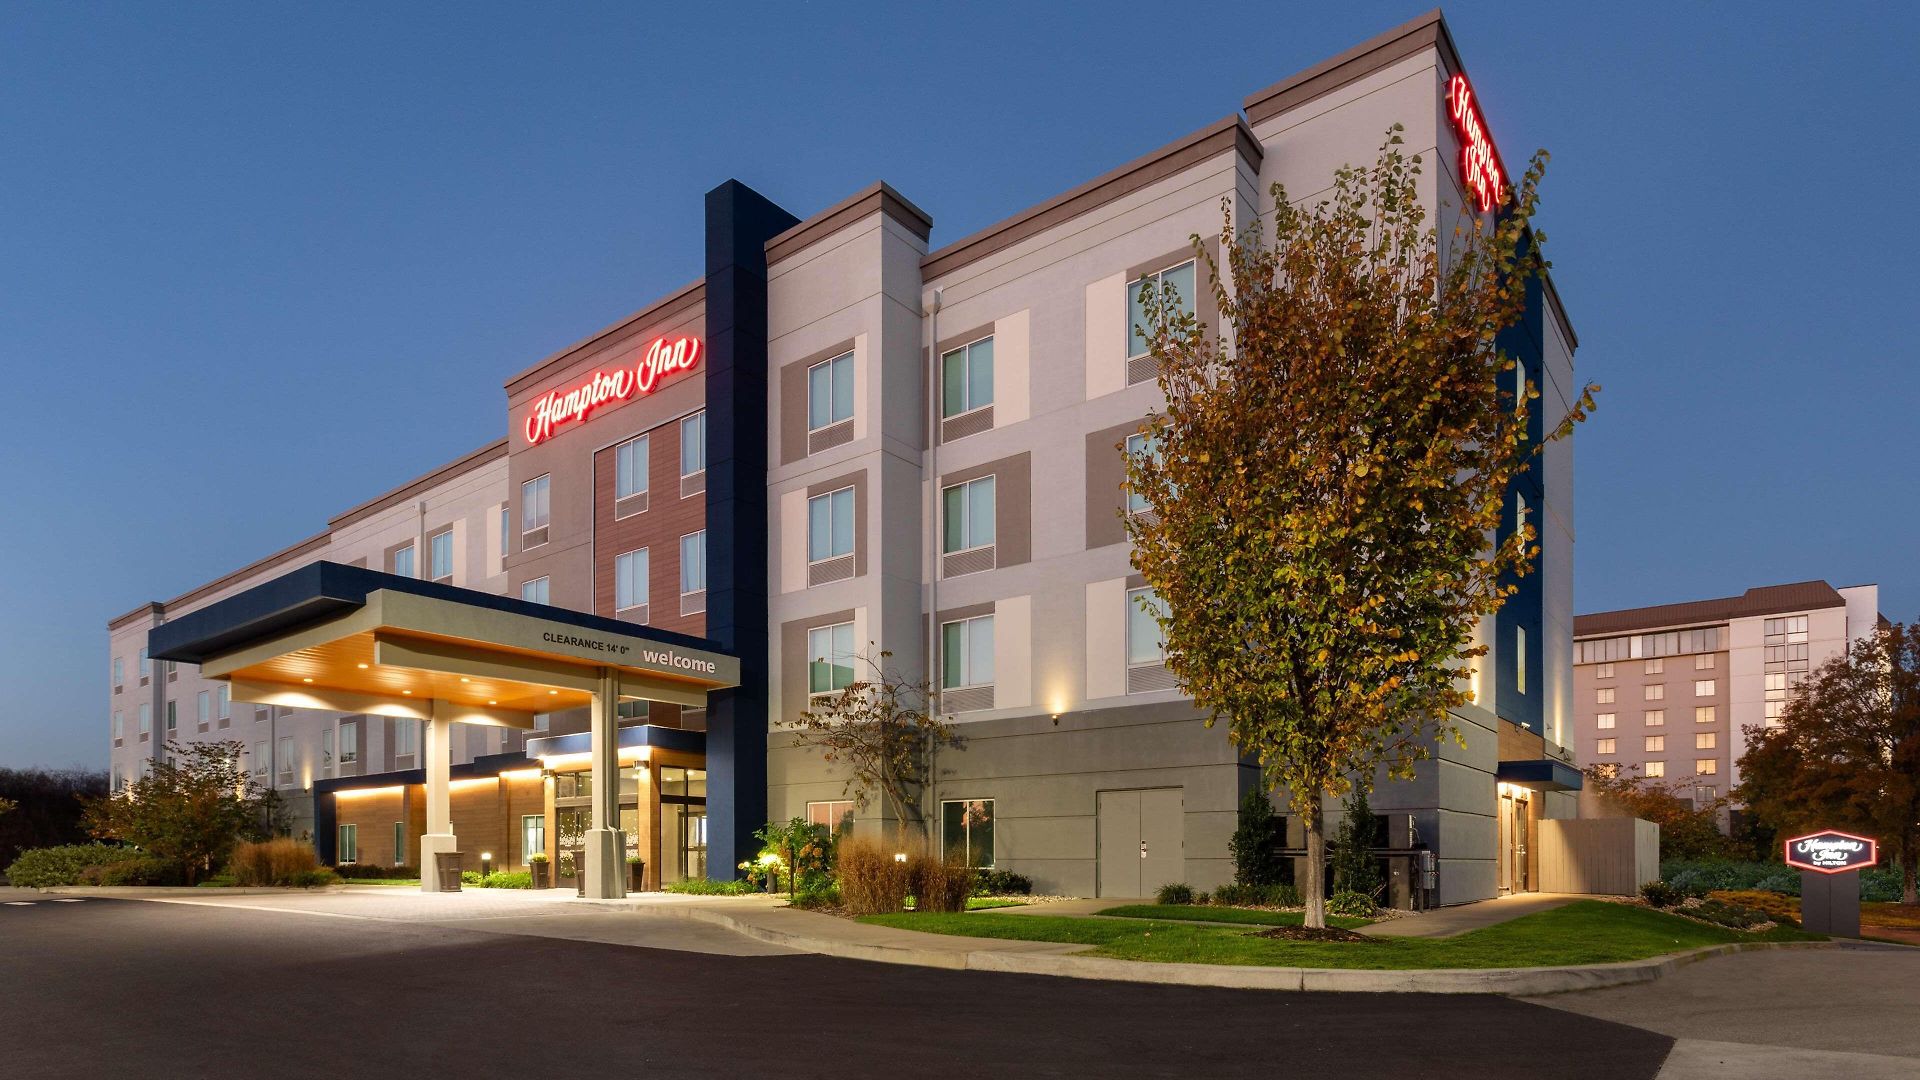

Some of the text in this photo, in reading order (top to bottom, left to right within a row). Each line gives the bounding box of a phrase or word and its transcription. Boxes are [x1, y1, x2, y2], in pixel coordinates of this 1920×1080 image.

[1452, 76, 1502, 204] Hampton
[1465, 146, 1490, 212] Inn
[525, 337, 700, 443] Hampton Inn
[543, 632, 604, 651] CLEARANCE
[643, 649, 716, 674] welcome
[1797, 838, 1863, 853] Hampton
[1812, 850, 1848, 861] Inn
